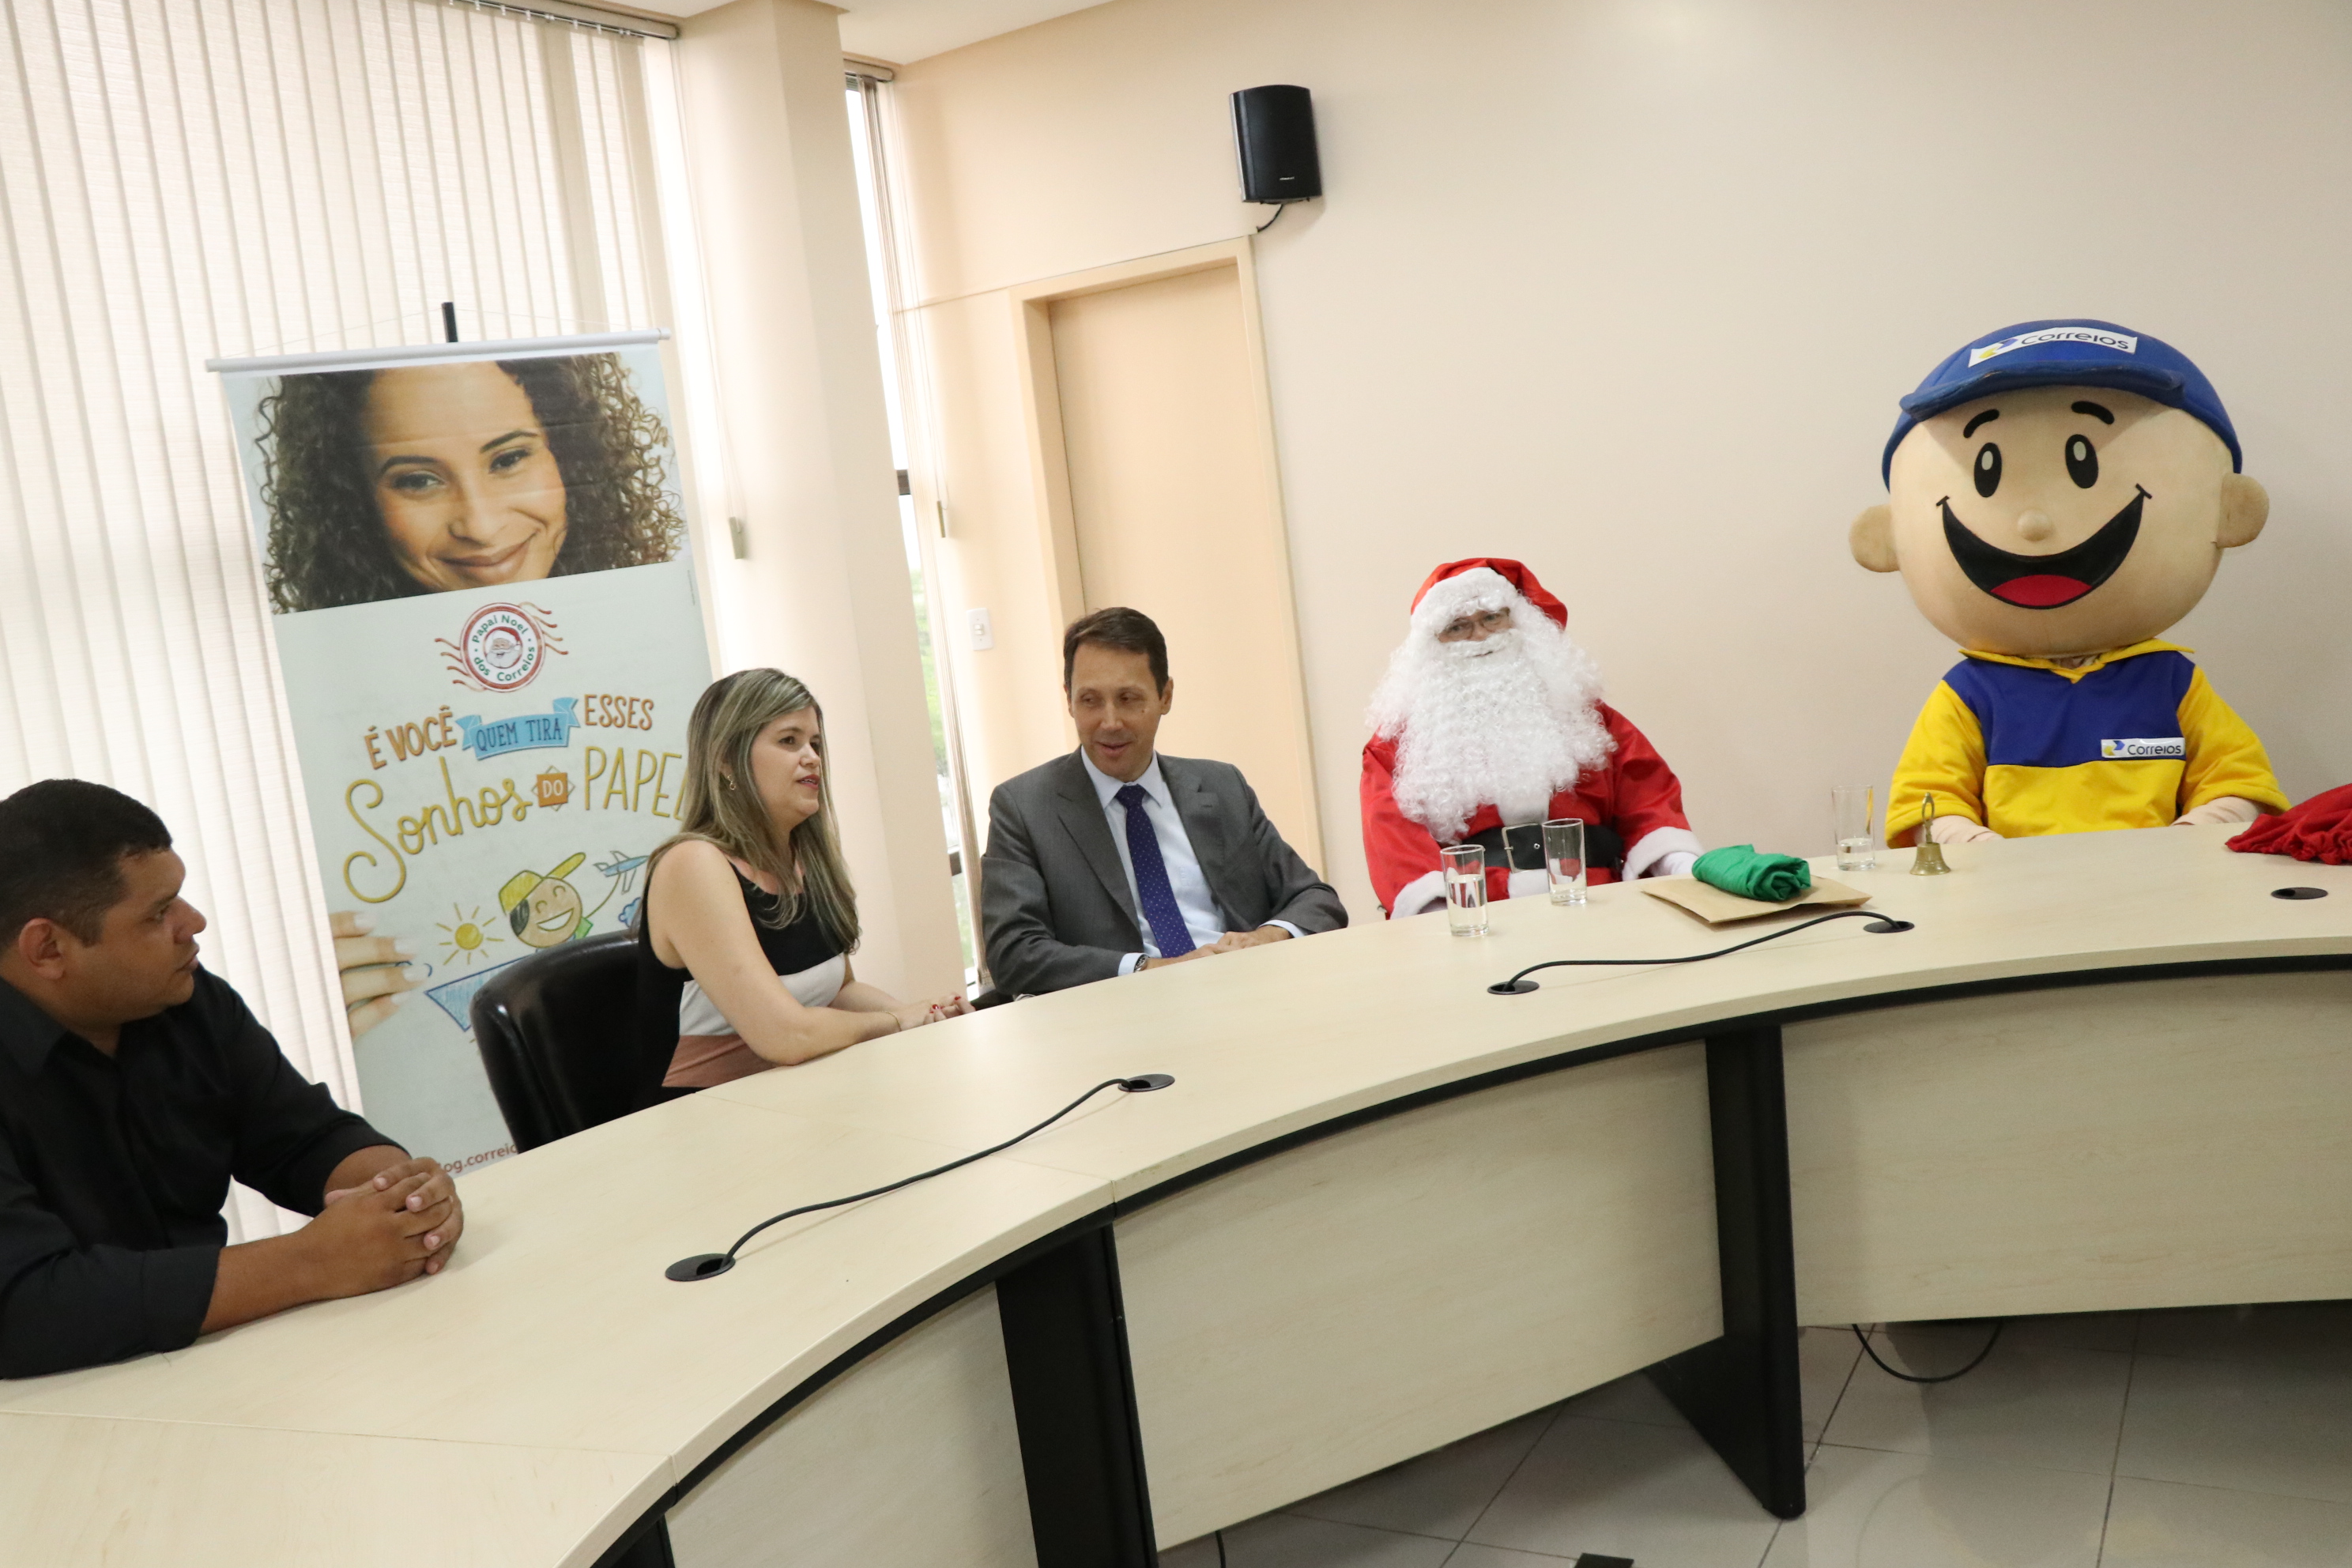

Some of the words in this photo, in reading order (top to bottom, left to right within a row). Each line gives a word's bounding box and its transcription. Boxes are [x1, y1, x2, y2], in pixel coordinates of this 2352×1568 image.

[2021, 332, 2129, 350] Correios
[472, 615, 498, 643] Papai
[501, 614, 529, 635] Noel
[473, 657, 491, 677] dos
[496, 646, 536, 681] Correios
[364, 725, 388, 770] É
[386, 704, 458, 761] VOCÊ
[476, 722, 518, 752] QUEM
[525, 718, 563, 742] TIRA
[583, 693, 654, 731] ESSES
[2127, 744, 2181, 756] Correios
[343, 755, 533, 904] Sonhos
[541, 779, 564, 798] DO
